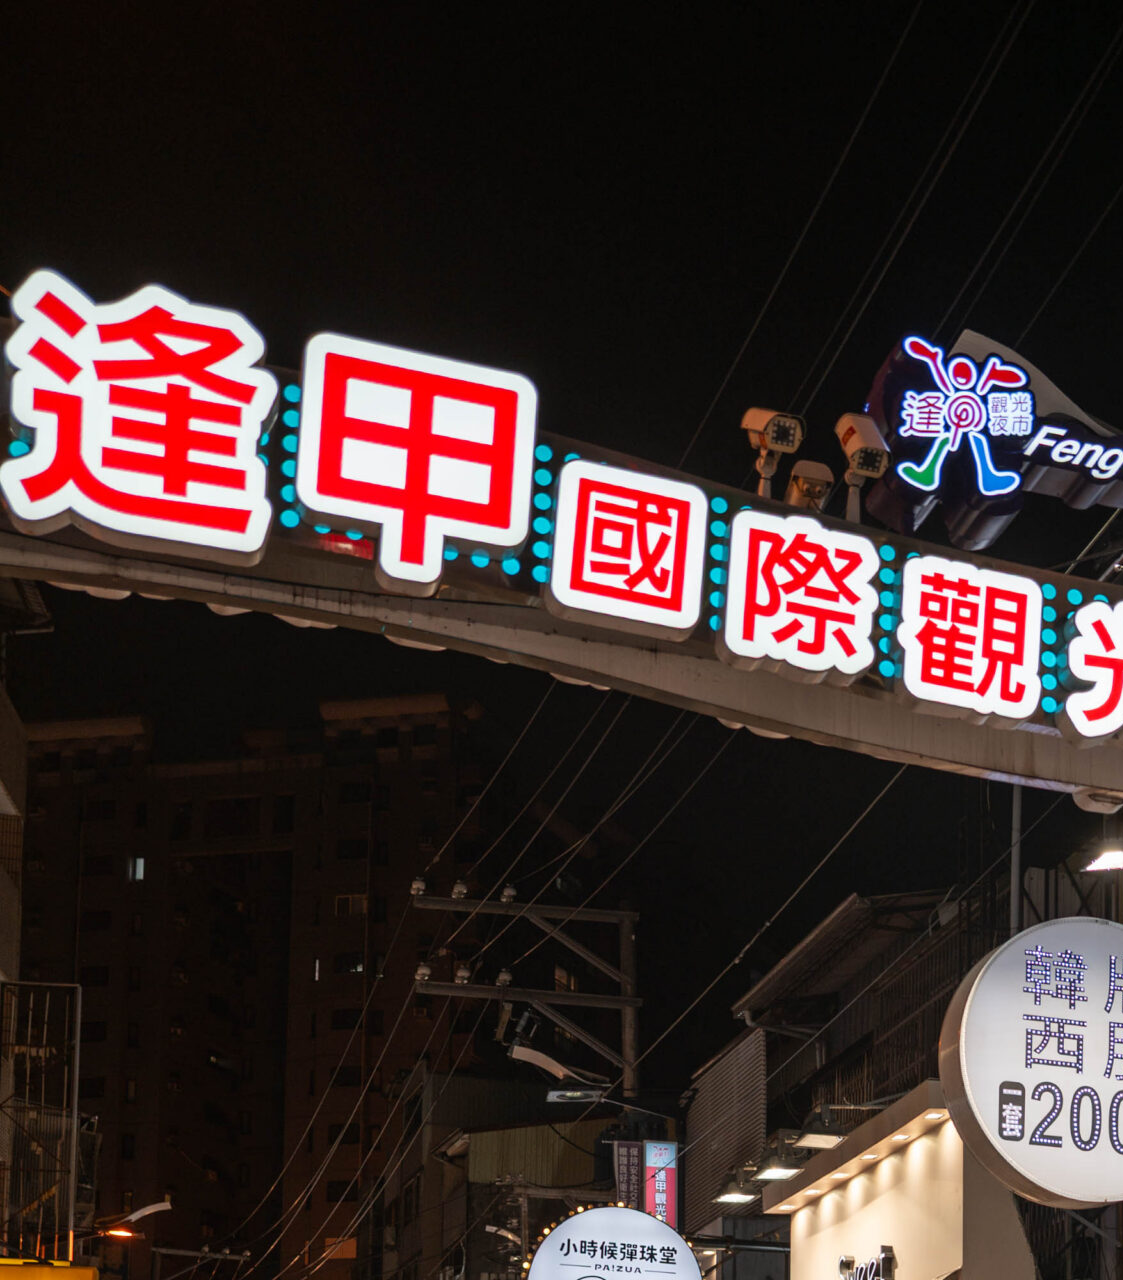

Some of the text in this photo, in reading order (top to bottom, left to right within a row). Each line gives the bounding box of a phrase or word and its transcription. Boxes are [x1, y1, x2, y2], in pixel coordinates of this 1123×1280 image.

[560, 1238, 677, 1265] 小時候彈珠堂
